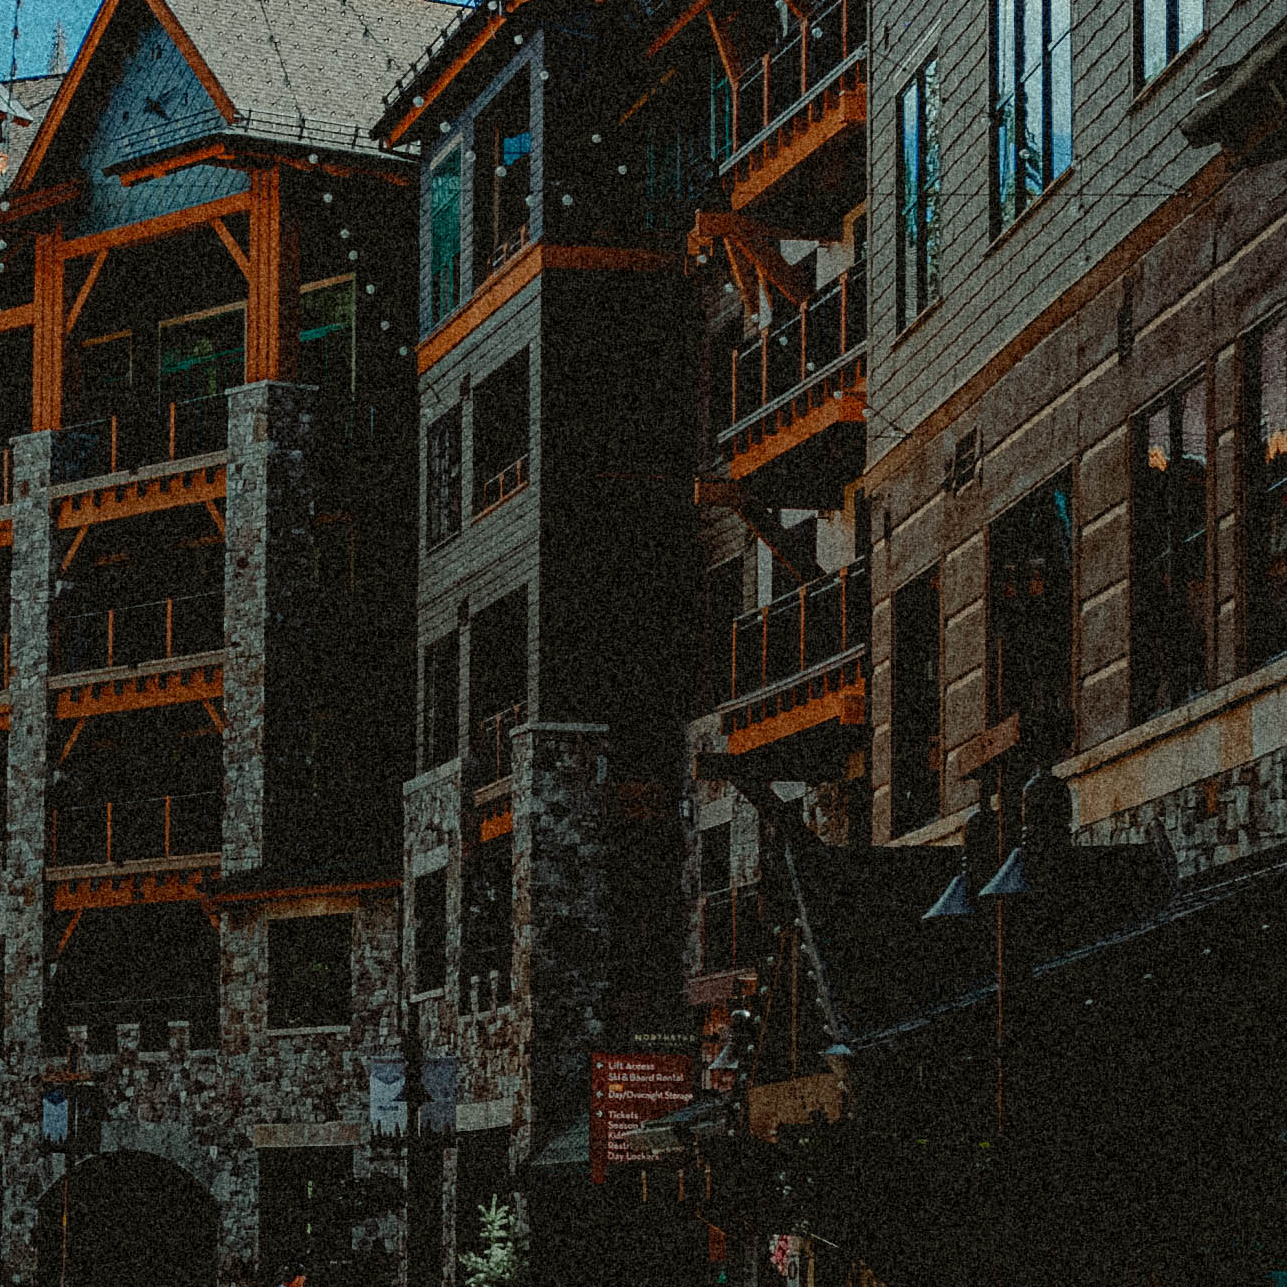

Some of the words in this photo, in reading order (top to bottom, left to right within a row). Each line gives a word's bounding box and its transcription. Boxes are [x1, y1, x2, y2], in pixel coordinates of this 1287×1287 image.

[608, 1062, 624, 1070] Lift
[626, 1062, 655, 1070] Access
[630, 1073, 655, 1082] Board
[656, 1073, 684, 1082] Rental
[608, 1090, 664, 1101] Day/Overnight
[665, 1091, 694, 1101] Storage
[608, 1111, 639, 1119] Tickets
[608, 1121, 639, 1130] Season
[608, 1151, 624, 1161] Day
[626, 1151, 660, 1161] Lockers
